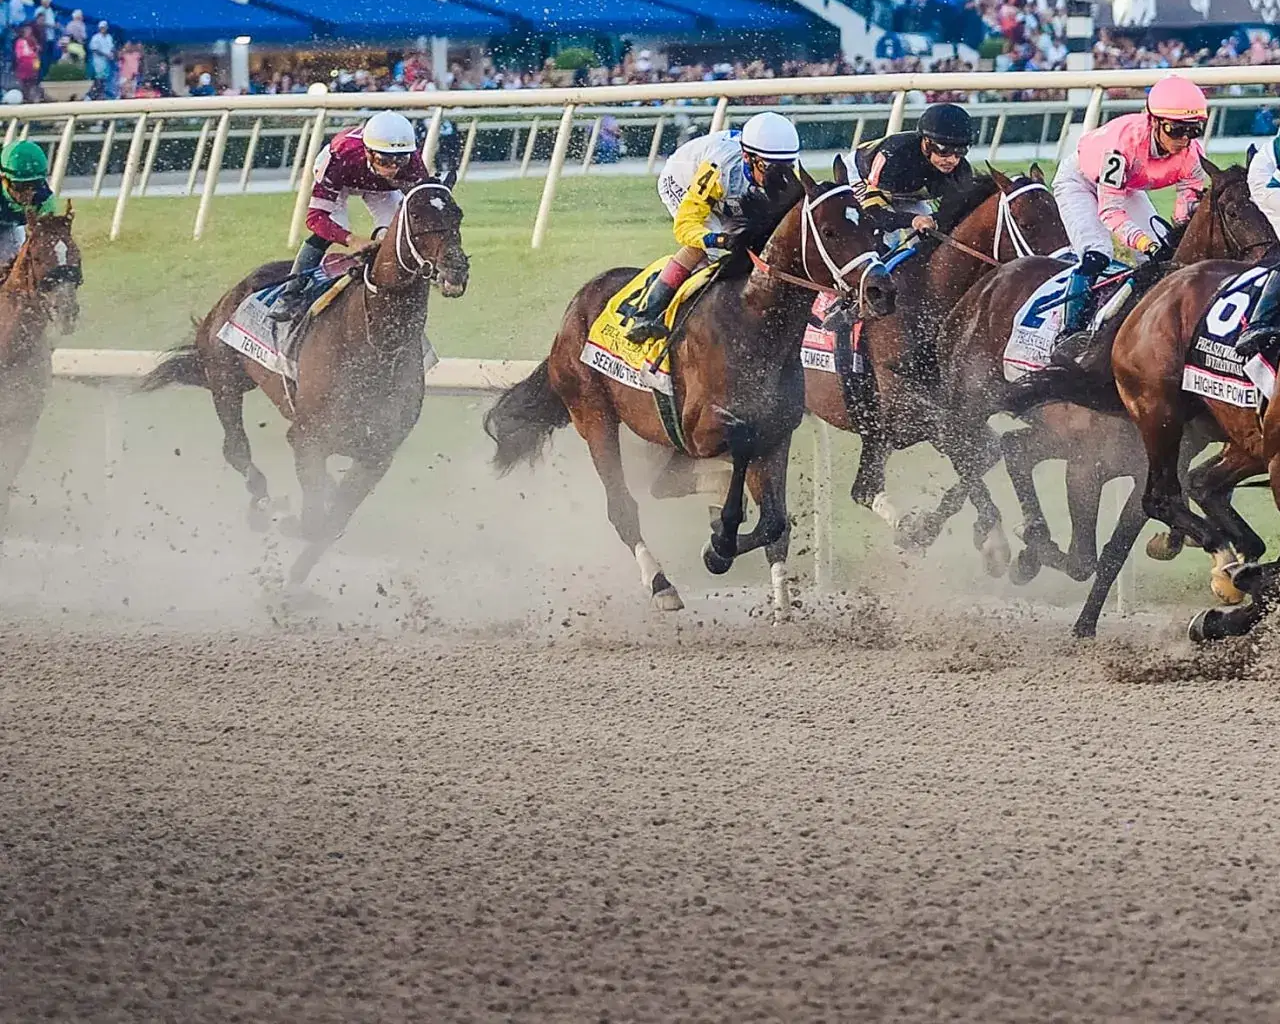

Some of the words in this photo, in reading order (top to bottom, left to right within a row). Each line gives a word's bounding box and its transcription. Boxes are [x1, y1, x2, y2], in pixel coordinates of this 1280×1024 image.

[697, 169, 715, 195] 4
[1104, 157, 1120, 185] 2
[1206, 266, 1269, 337] 6
[241, 336, 269, 364] TENFOL
[593, 351, 626, 379] SEEKING
[1194, 374, 1224, 398] HIGHER
